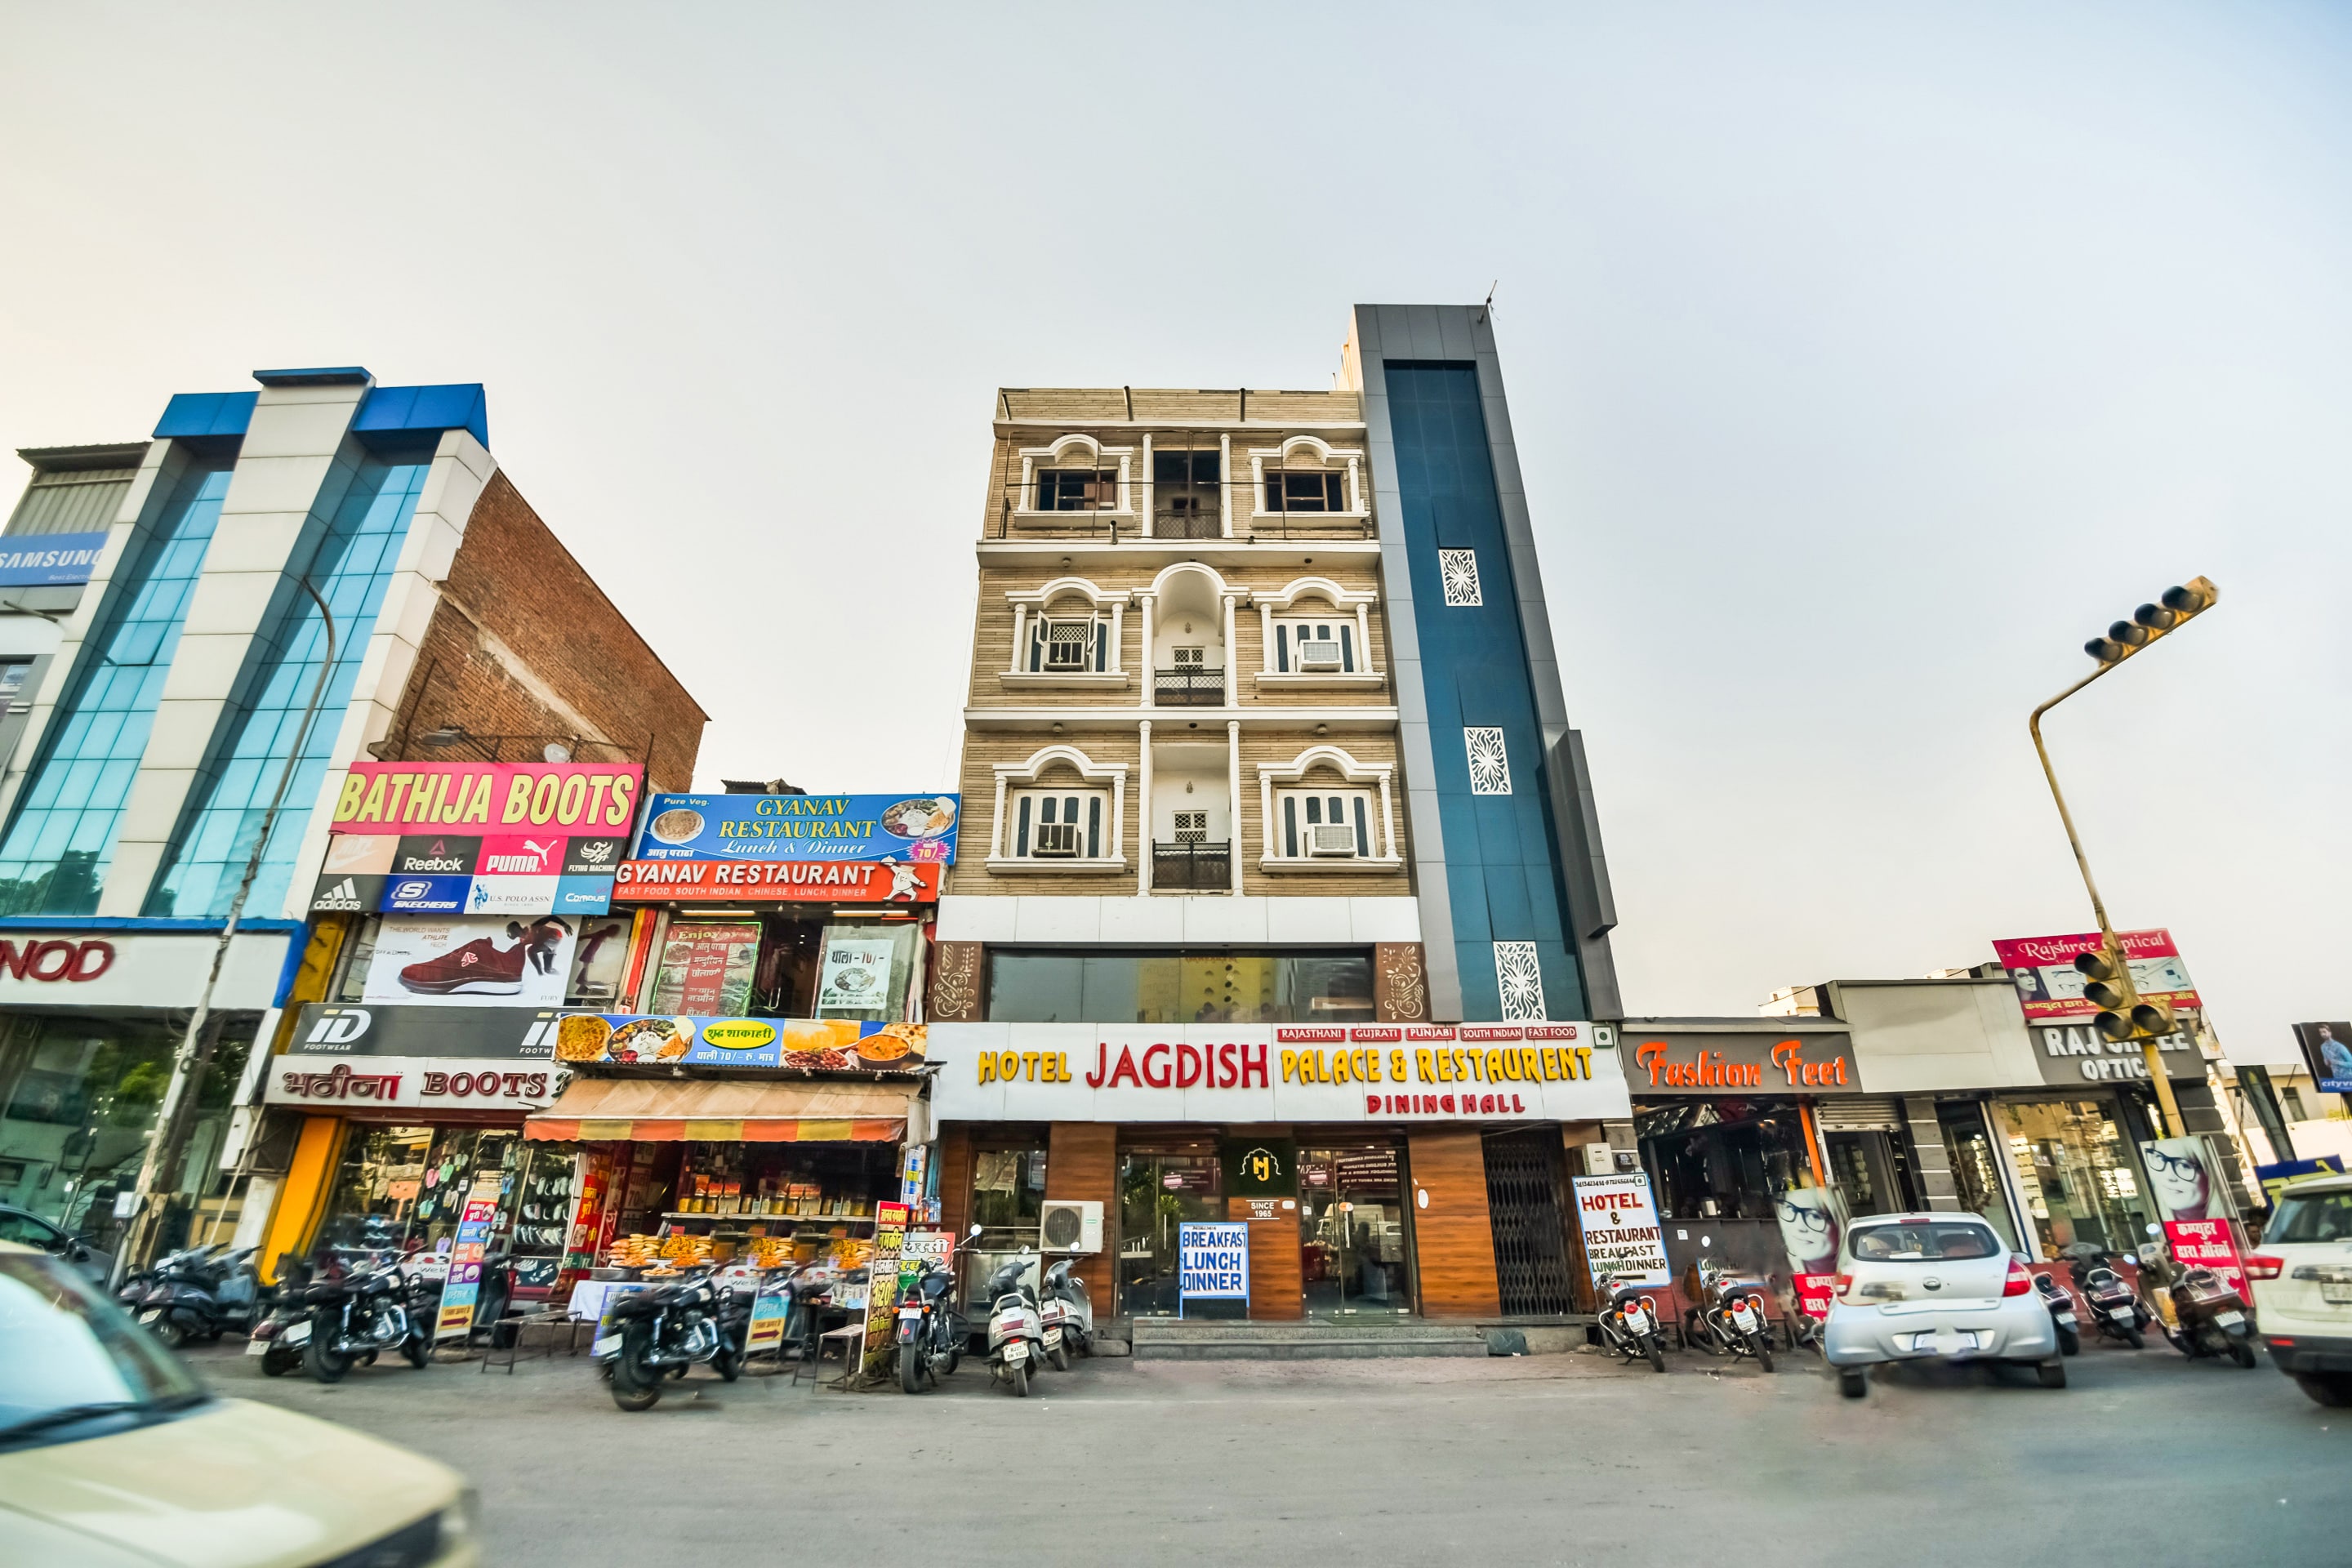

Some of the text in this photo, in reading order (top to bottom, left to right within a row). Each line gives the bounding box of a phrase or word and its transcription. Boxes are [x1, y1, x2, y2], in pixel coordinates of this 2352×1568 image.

[331, 773, 635, 826] BATHIJA BOOTS
[663, 797, 710, 807] Pure Veg.
[755, 799, 850, 817] GYANAV
[718, 820, 877, 839] RESTAURANT
[720, 840, 866, 855] Lunch & Dinner
[486, 855, 541, 874] PUMA
[568, 864, 617, 872] FLYING MACHINE
[615, 863, 875, 886] GYANAV RESTAURANT
[617, 887, 641, 896] FAST
[675, 887, 707, 896] SOUTH
[747, 888, 791, 897] CHINESE,
[794, 888, 829, 897] LUNCH,
[832, 889, 866, 897] DINNER
[314, 900, 362, 911] adidas
[392, 901, 459, 910] SKECHERS
[2017, 931, 2166, 961] Rajshree ptical
[1281, 1028, 1342, 1038] RAJASTHANI
[1355, 1028, 1398, 1038] GUJRATI
[1410, 1027, 1453, 1037] PUNJABI
[1463, 1027, 1522, 1038] SOUTH INDIAN
[1527, 1027, 1576, 1037] FAST FOOD
[304, 1044, 352, 1052] FOOTWEAR
[697, 1049, 719, 1061] थाली
[978, 1042, 1593, 1089] HOTEL JAGDISH PALACE & RESTAURENT
[1635, 1039, 1849, 1088] Fashion Feet
[2081, 1057, 2174, 1080] OPTIC
[421, 1071, 548, 1098] BOOTS
[1365, 1093, 1526, 1115] DINING HALL
[1250, 1201, 1275, 1209] SINCE
[1580, 1192, 1644, 1212] HOTEL
[1254, 1209, 1272, 1218] 1965
[1610, 1211, 1622, 1226] &
[1183, 1231, 1246, 1248] BREAKFAST
[1584, 1226, 1662, 1245] RESTAURANT
[1588, 1244, 1657, 1260] BREAKFAST
[1183, 1252, 1241, 1271] LUNCH
[1627, 1258, 1667, 1271] DINNER
[1183, 1272, 1243, 1291] DINNER
